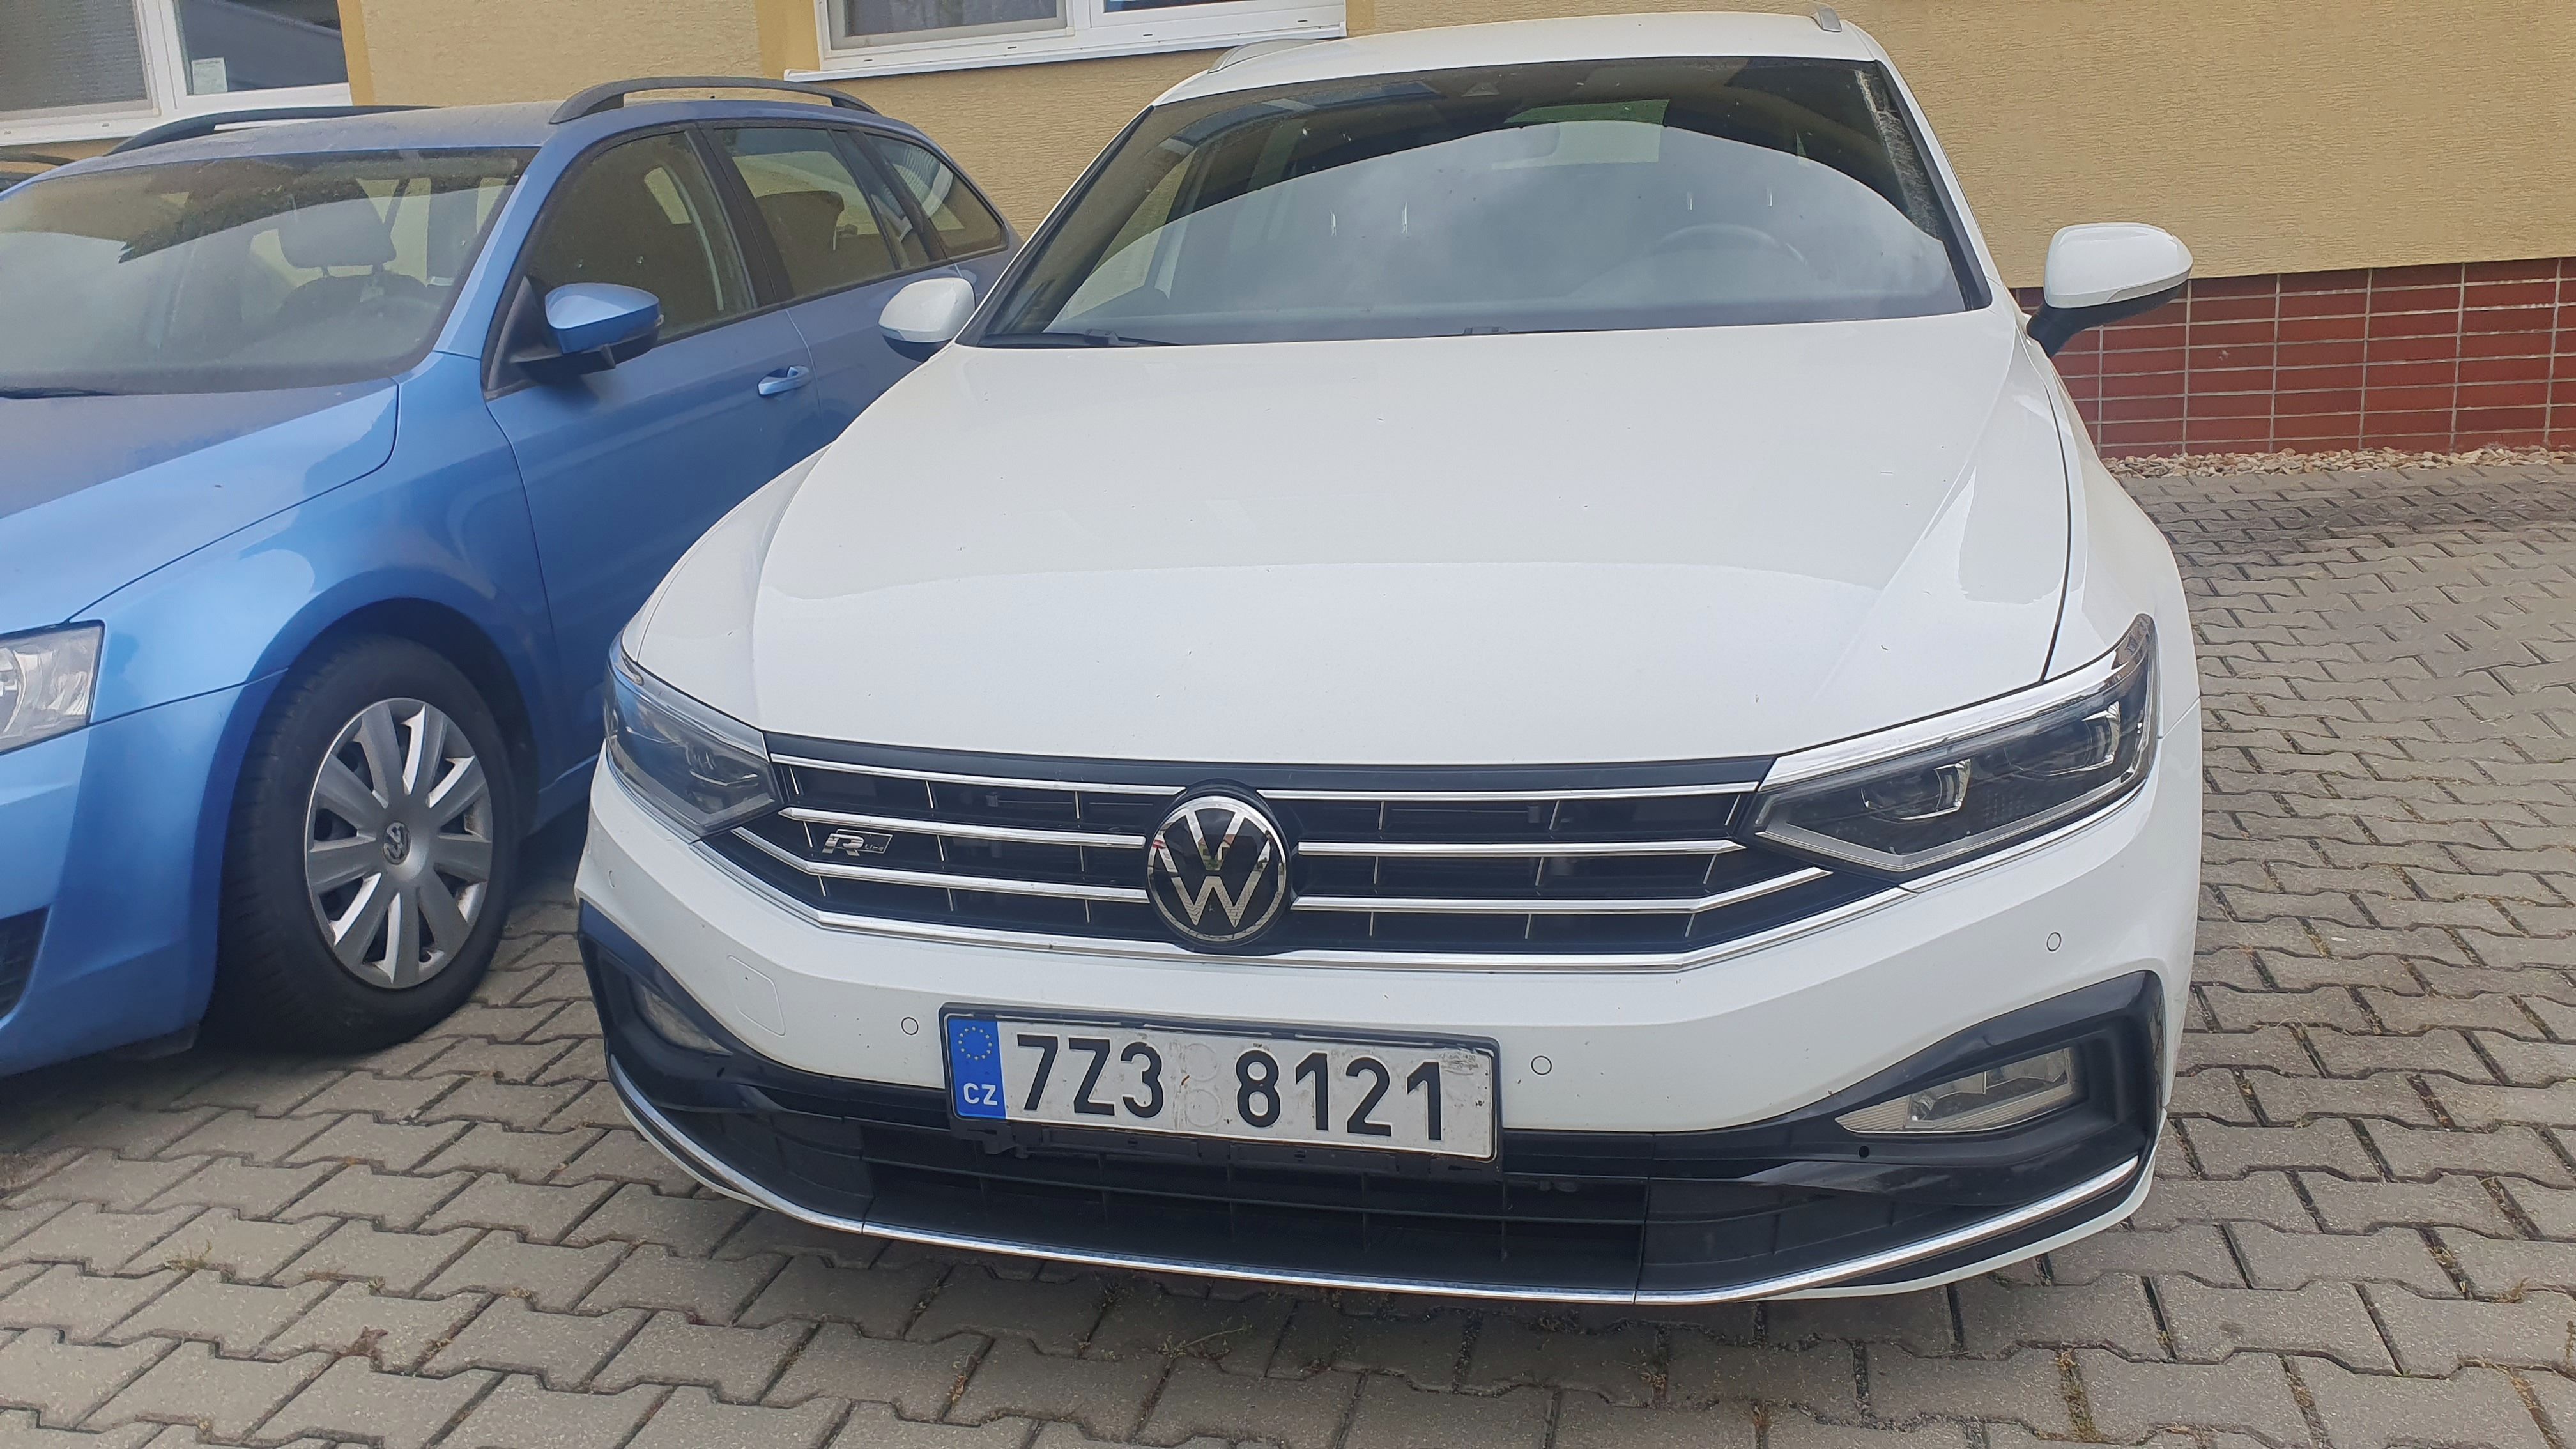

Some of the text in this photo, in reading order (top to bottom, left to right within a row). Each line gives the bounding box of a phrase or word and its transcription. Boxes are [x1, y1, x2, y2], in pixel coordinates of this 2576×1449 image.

[1151, 804, 1274, 928] VW
[963, 1082, 998, 1106] CZ
[1016, 1034, 1443, 1141] 7Z3 8121
